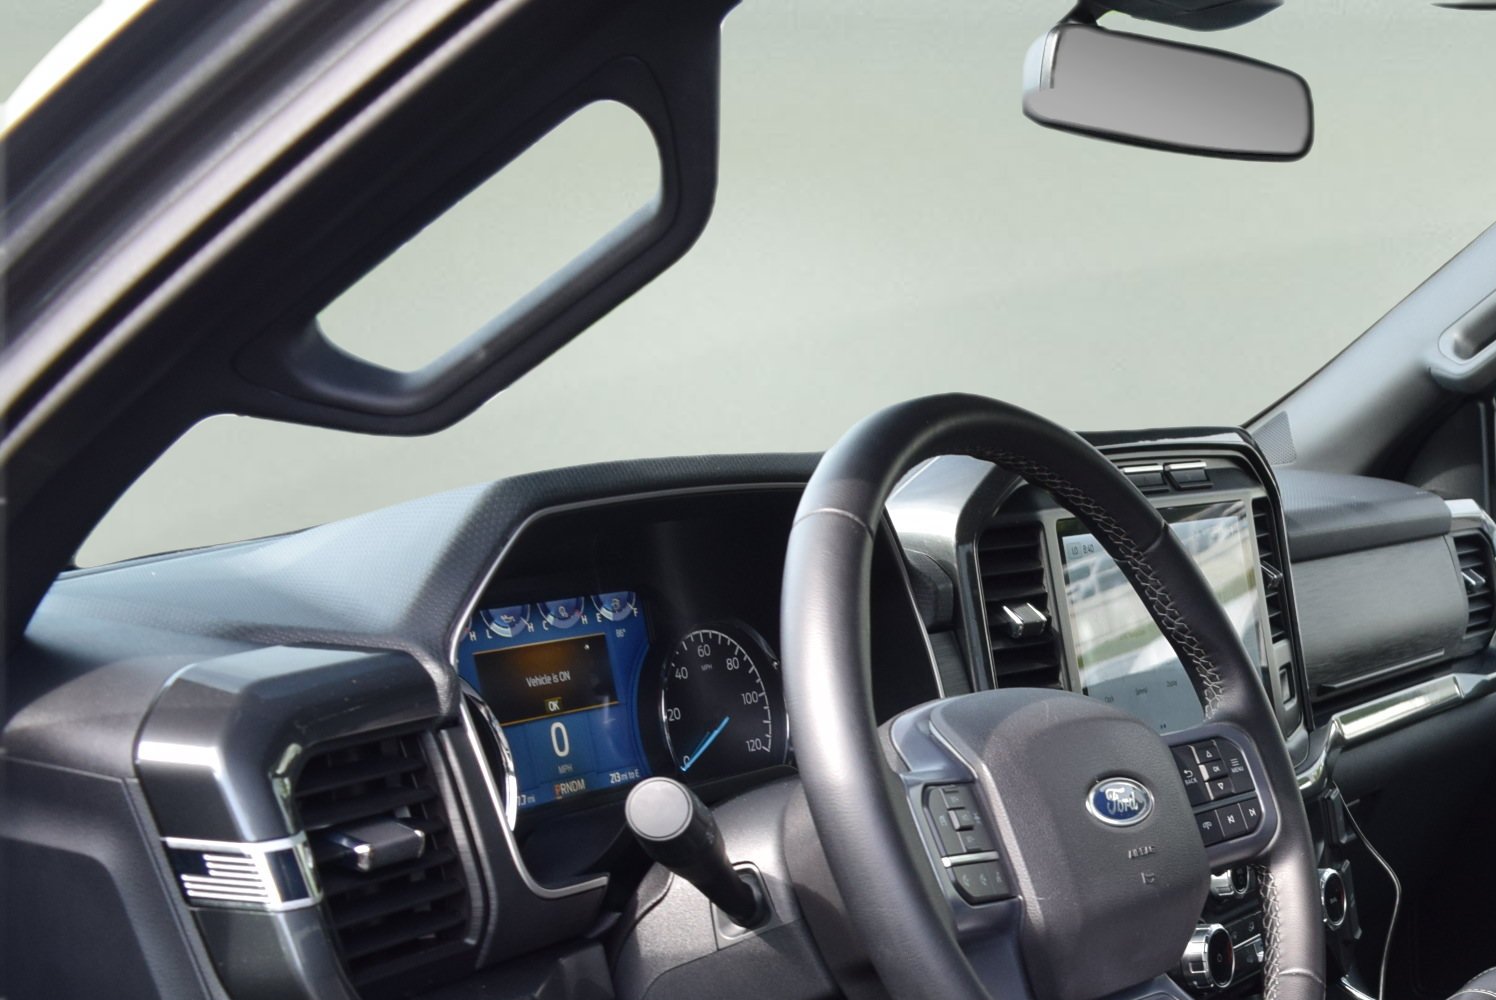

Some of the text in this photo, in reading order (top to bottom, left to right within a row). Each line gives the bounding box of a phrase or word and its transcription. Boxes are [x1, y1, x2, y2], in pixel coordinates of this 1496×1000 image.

[581, 615, 588, 625] H
[596, 614, 602, 623] E
[527, 623, 535, 633] H
[542, 621, 549, 631] C
[469, 632, 477, 641] H
[486, 630, 493, 639] L
[697, 644, 711, 657] 60
[726, 657, 740, 670] 80
[675, 667, 688, 679] 40
[526, 674, 551, 688] Vehicle
[559, 671, 571, 682] ON
[741, 691, 758, 705] 100
[548, 701, 560, 712] OK
[667, 707, 681, 721] 20
[551, 721, 570, 757] 0
[746, 738, 761, 752] 120
[1104, 786, 1139, 815] Ford
